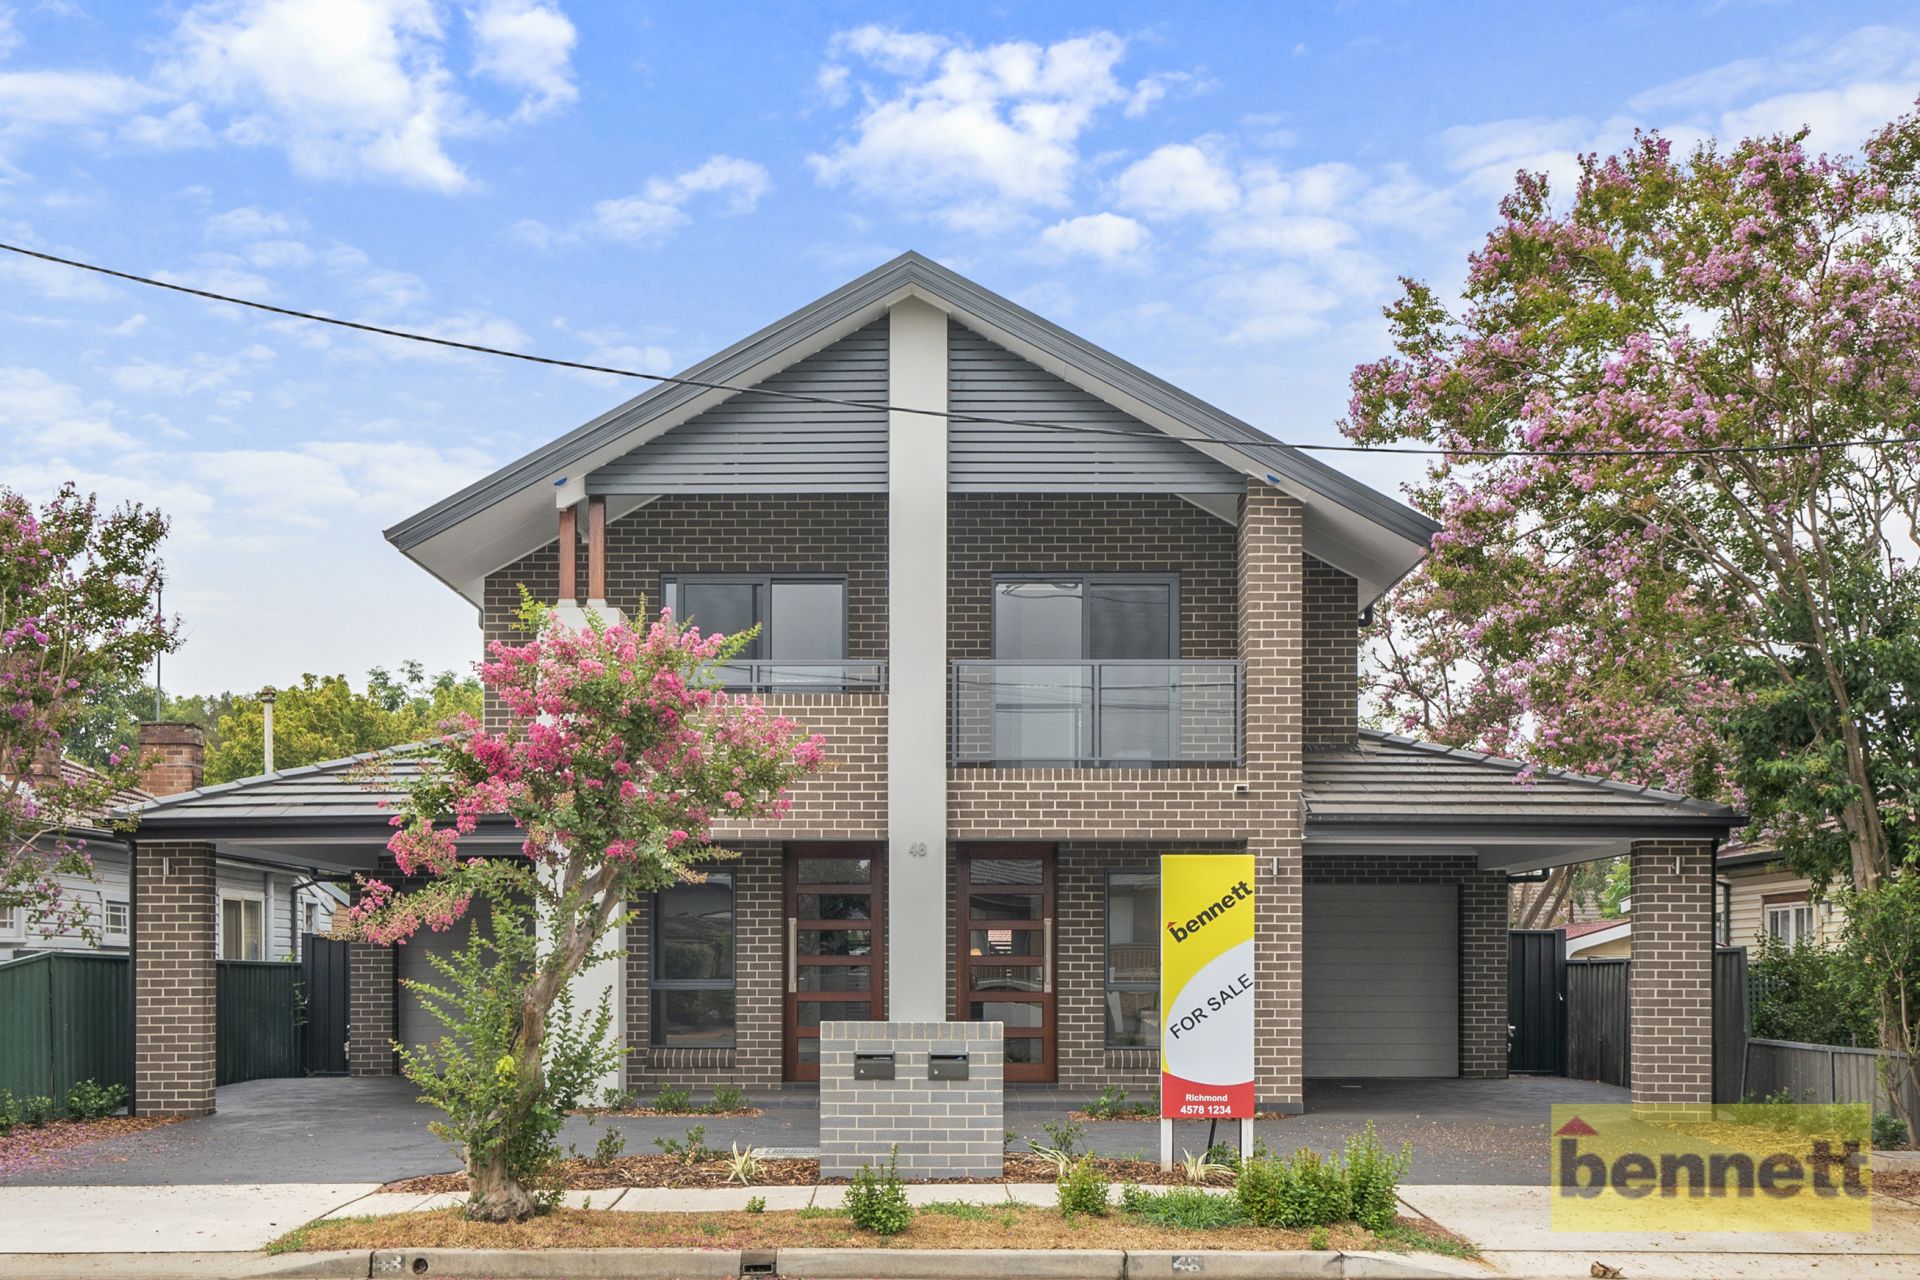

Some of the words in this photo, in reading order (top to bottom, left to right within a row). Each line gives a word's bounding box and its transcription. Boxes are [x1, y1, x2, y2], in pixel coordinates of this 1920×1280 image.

[908, 841, 928, 857] 48
[1168, 880, 1253, 943] bennett
[1169, 1007, 1208, 1039] FOR
[1207, 973, 1253, 1012] SALE
[1185, 1093, 1228, 1102] Richmond
[1180, 1105, 1205, 1114] 4578
[1207, 1105, 1231, 1114] 1234
